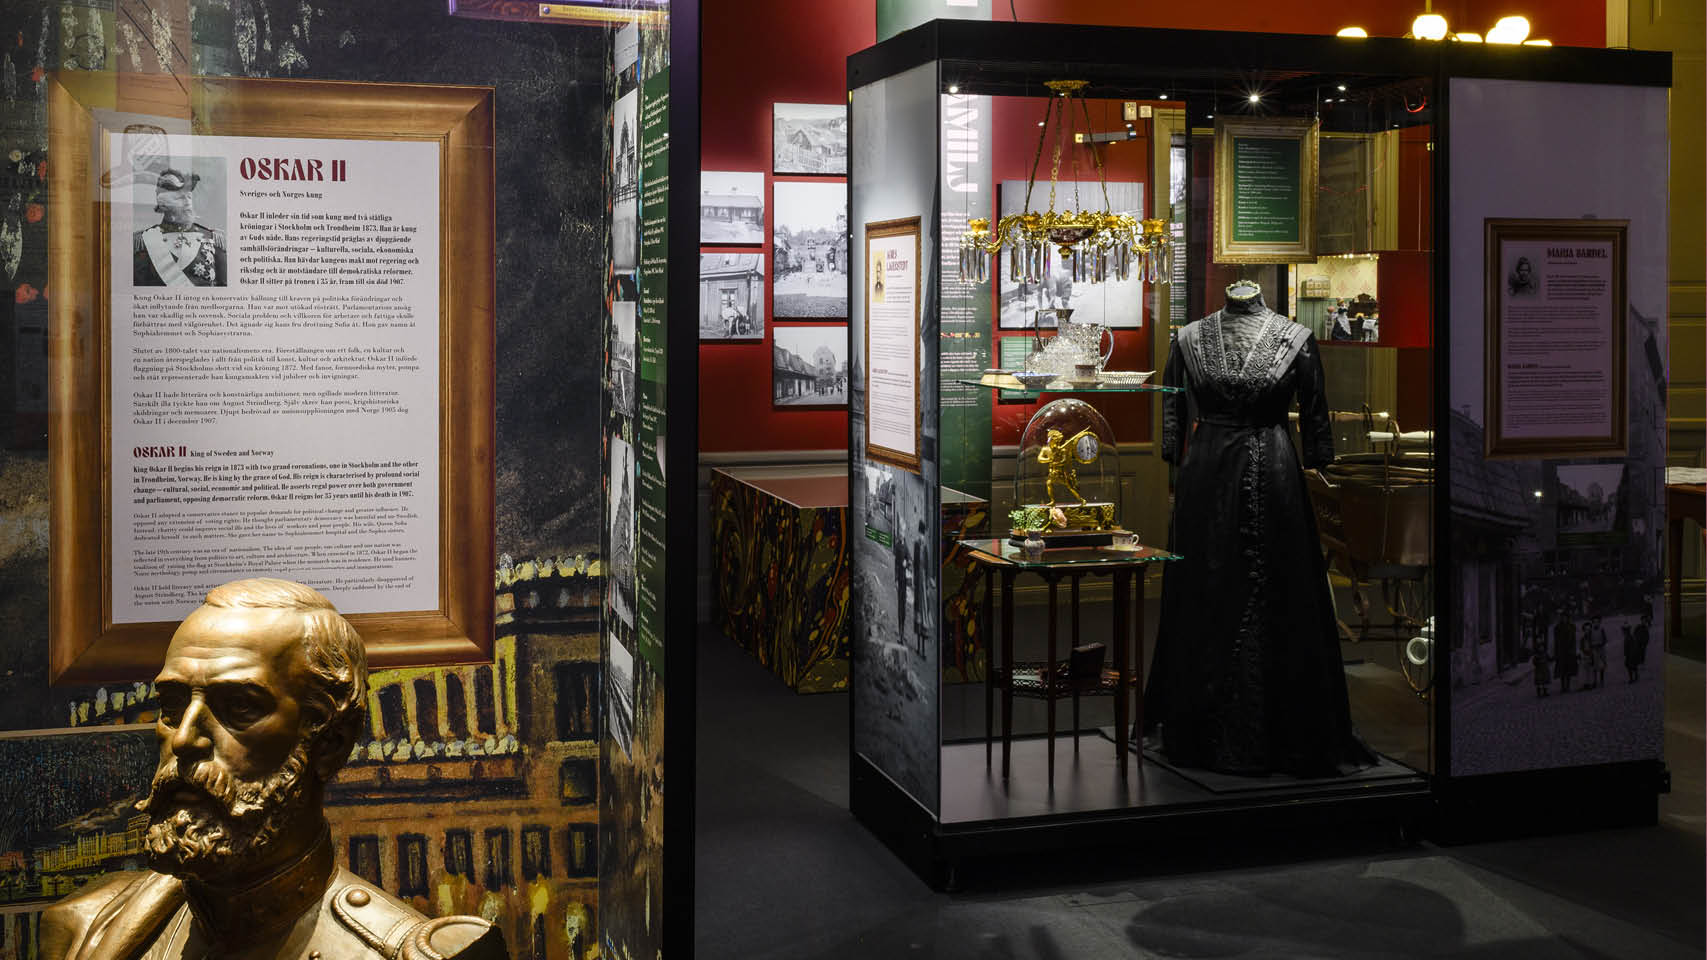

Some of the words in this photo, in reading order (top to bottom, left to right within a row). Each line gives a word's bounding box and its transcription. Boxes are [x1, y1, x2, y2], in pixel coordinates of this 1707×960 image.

[240, 157, 324, 181] OSKAR
[331, 160, 346, 182] II
[240, 191, 268, 199] Sveriges
[240, 223, 273, 231] kröningar
[133, 446, 175, 458] OSKAR
[179, 446, 187, 457] II
[377, 481, 413, 489] government
